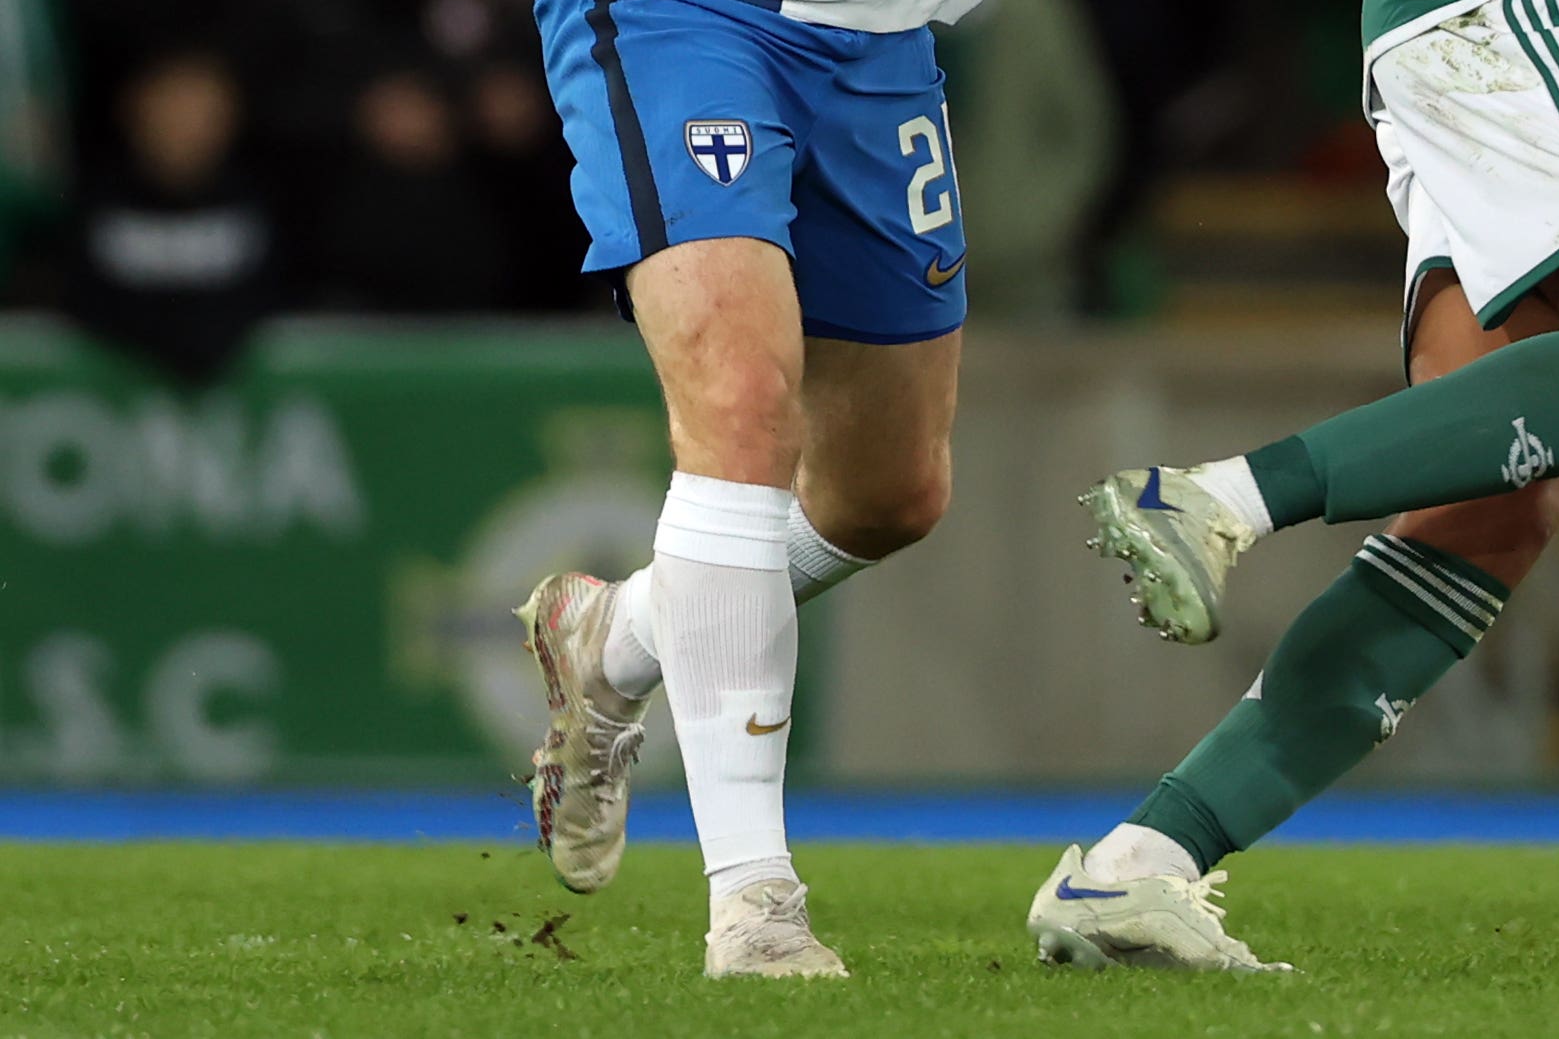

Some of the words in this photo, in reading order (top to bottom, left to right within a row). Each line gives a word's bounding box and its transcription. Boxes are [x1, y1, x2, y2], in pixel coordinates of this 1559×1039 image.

[695, 126, 738, 134] SUOMI
[898, 101, 966, 247] 2
[0, 392, 364, 542] ONA
